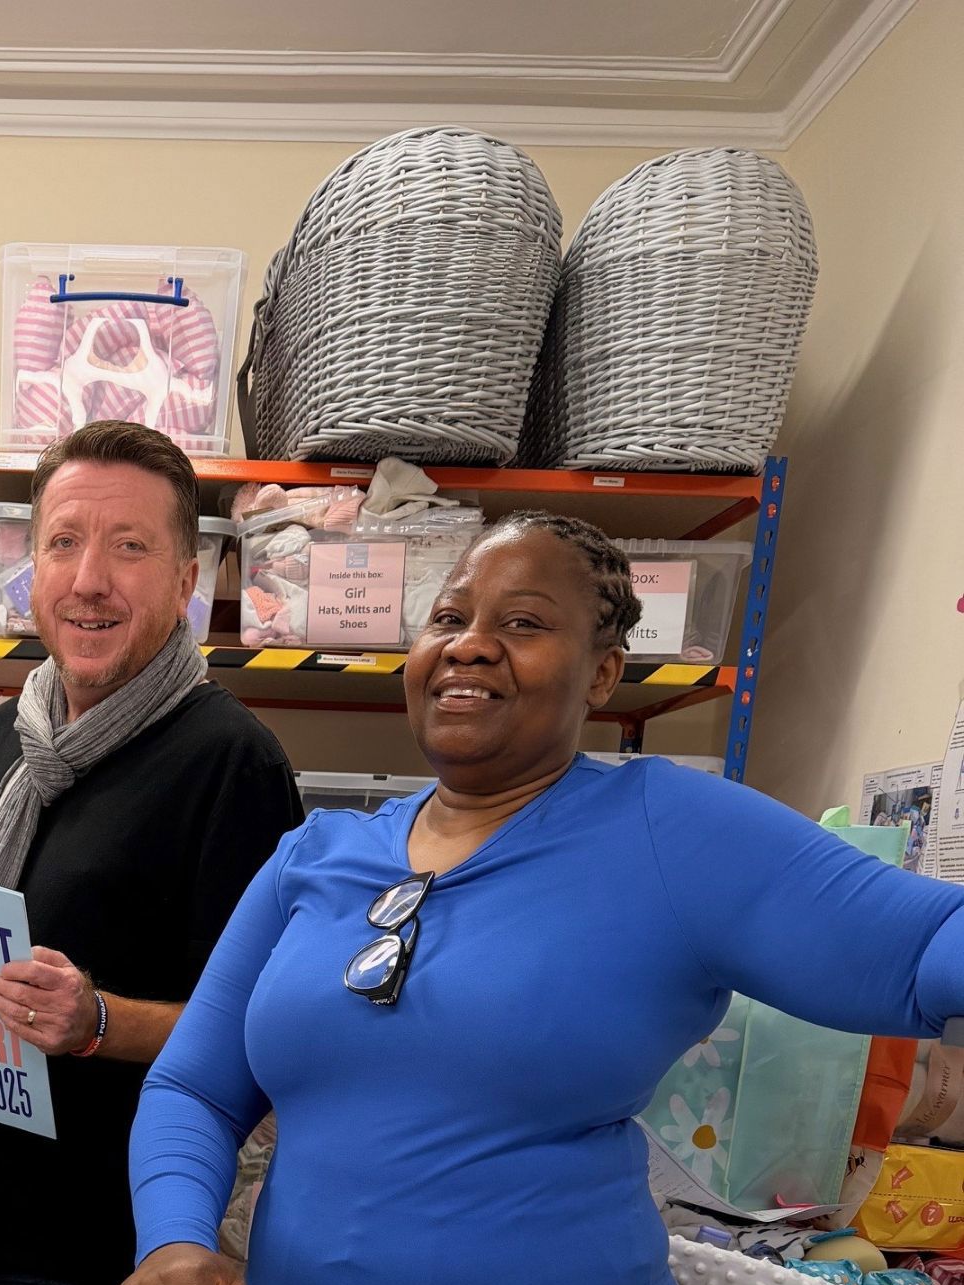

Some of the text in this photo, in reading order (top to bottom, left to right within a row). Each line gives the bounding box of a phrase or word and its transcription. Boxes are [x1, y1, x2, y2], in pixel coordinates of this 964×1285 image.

[329, 570, 384, 580] Inside this box:
[631, 572, 660, 584] box:
[344, 587, 366, 599] Girl
[318, 604, 391, 616] Hats, Mitts and
[339, 619, 368, 629] Shoes
